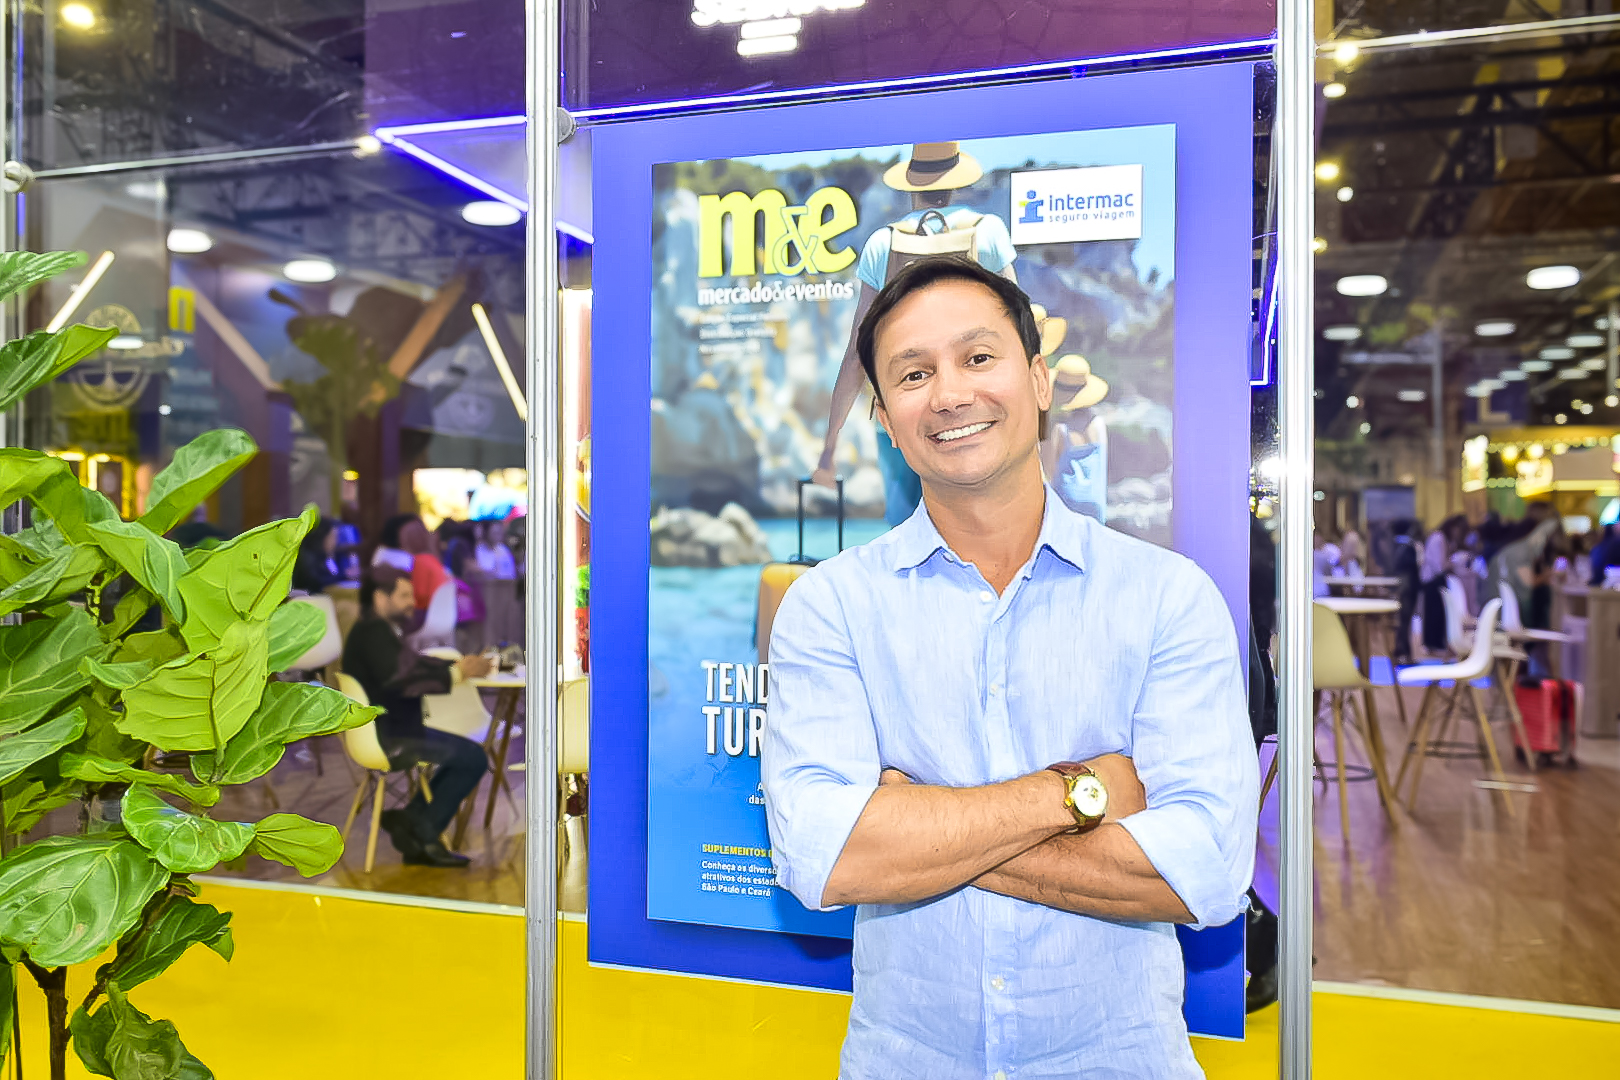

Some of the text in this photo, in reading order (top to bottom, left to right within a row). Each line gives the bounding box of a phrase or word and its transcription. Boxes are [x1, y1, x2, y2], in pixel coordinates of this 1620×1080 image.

[1049, 193, 1134, 211] intermac
[1049, 210, 1135, 224] seguro viagem
[698, 186, 858, 277] m&e
[698, 279, 854, 305] mercado&eventos
[701, 705, 767, 757] TUR
[702, 844, 767, 857] SUPLEMENTOS
[701, 861, 736, 873] Conheça
[701, 872, 736, 882] atrativos
[737, 875, 751, 883] dos
[701, 882, 717, 892] São
[718, 884, 740, 894] Paulo
[747, 887, 771, 897] Ceará
